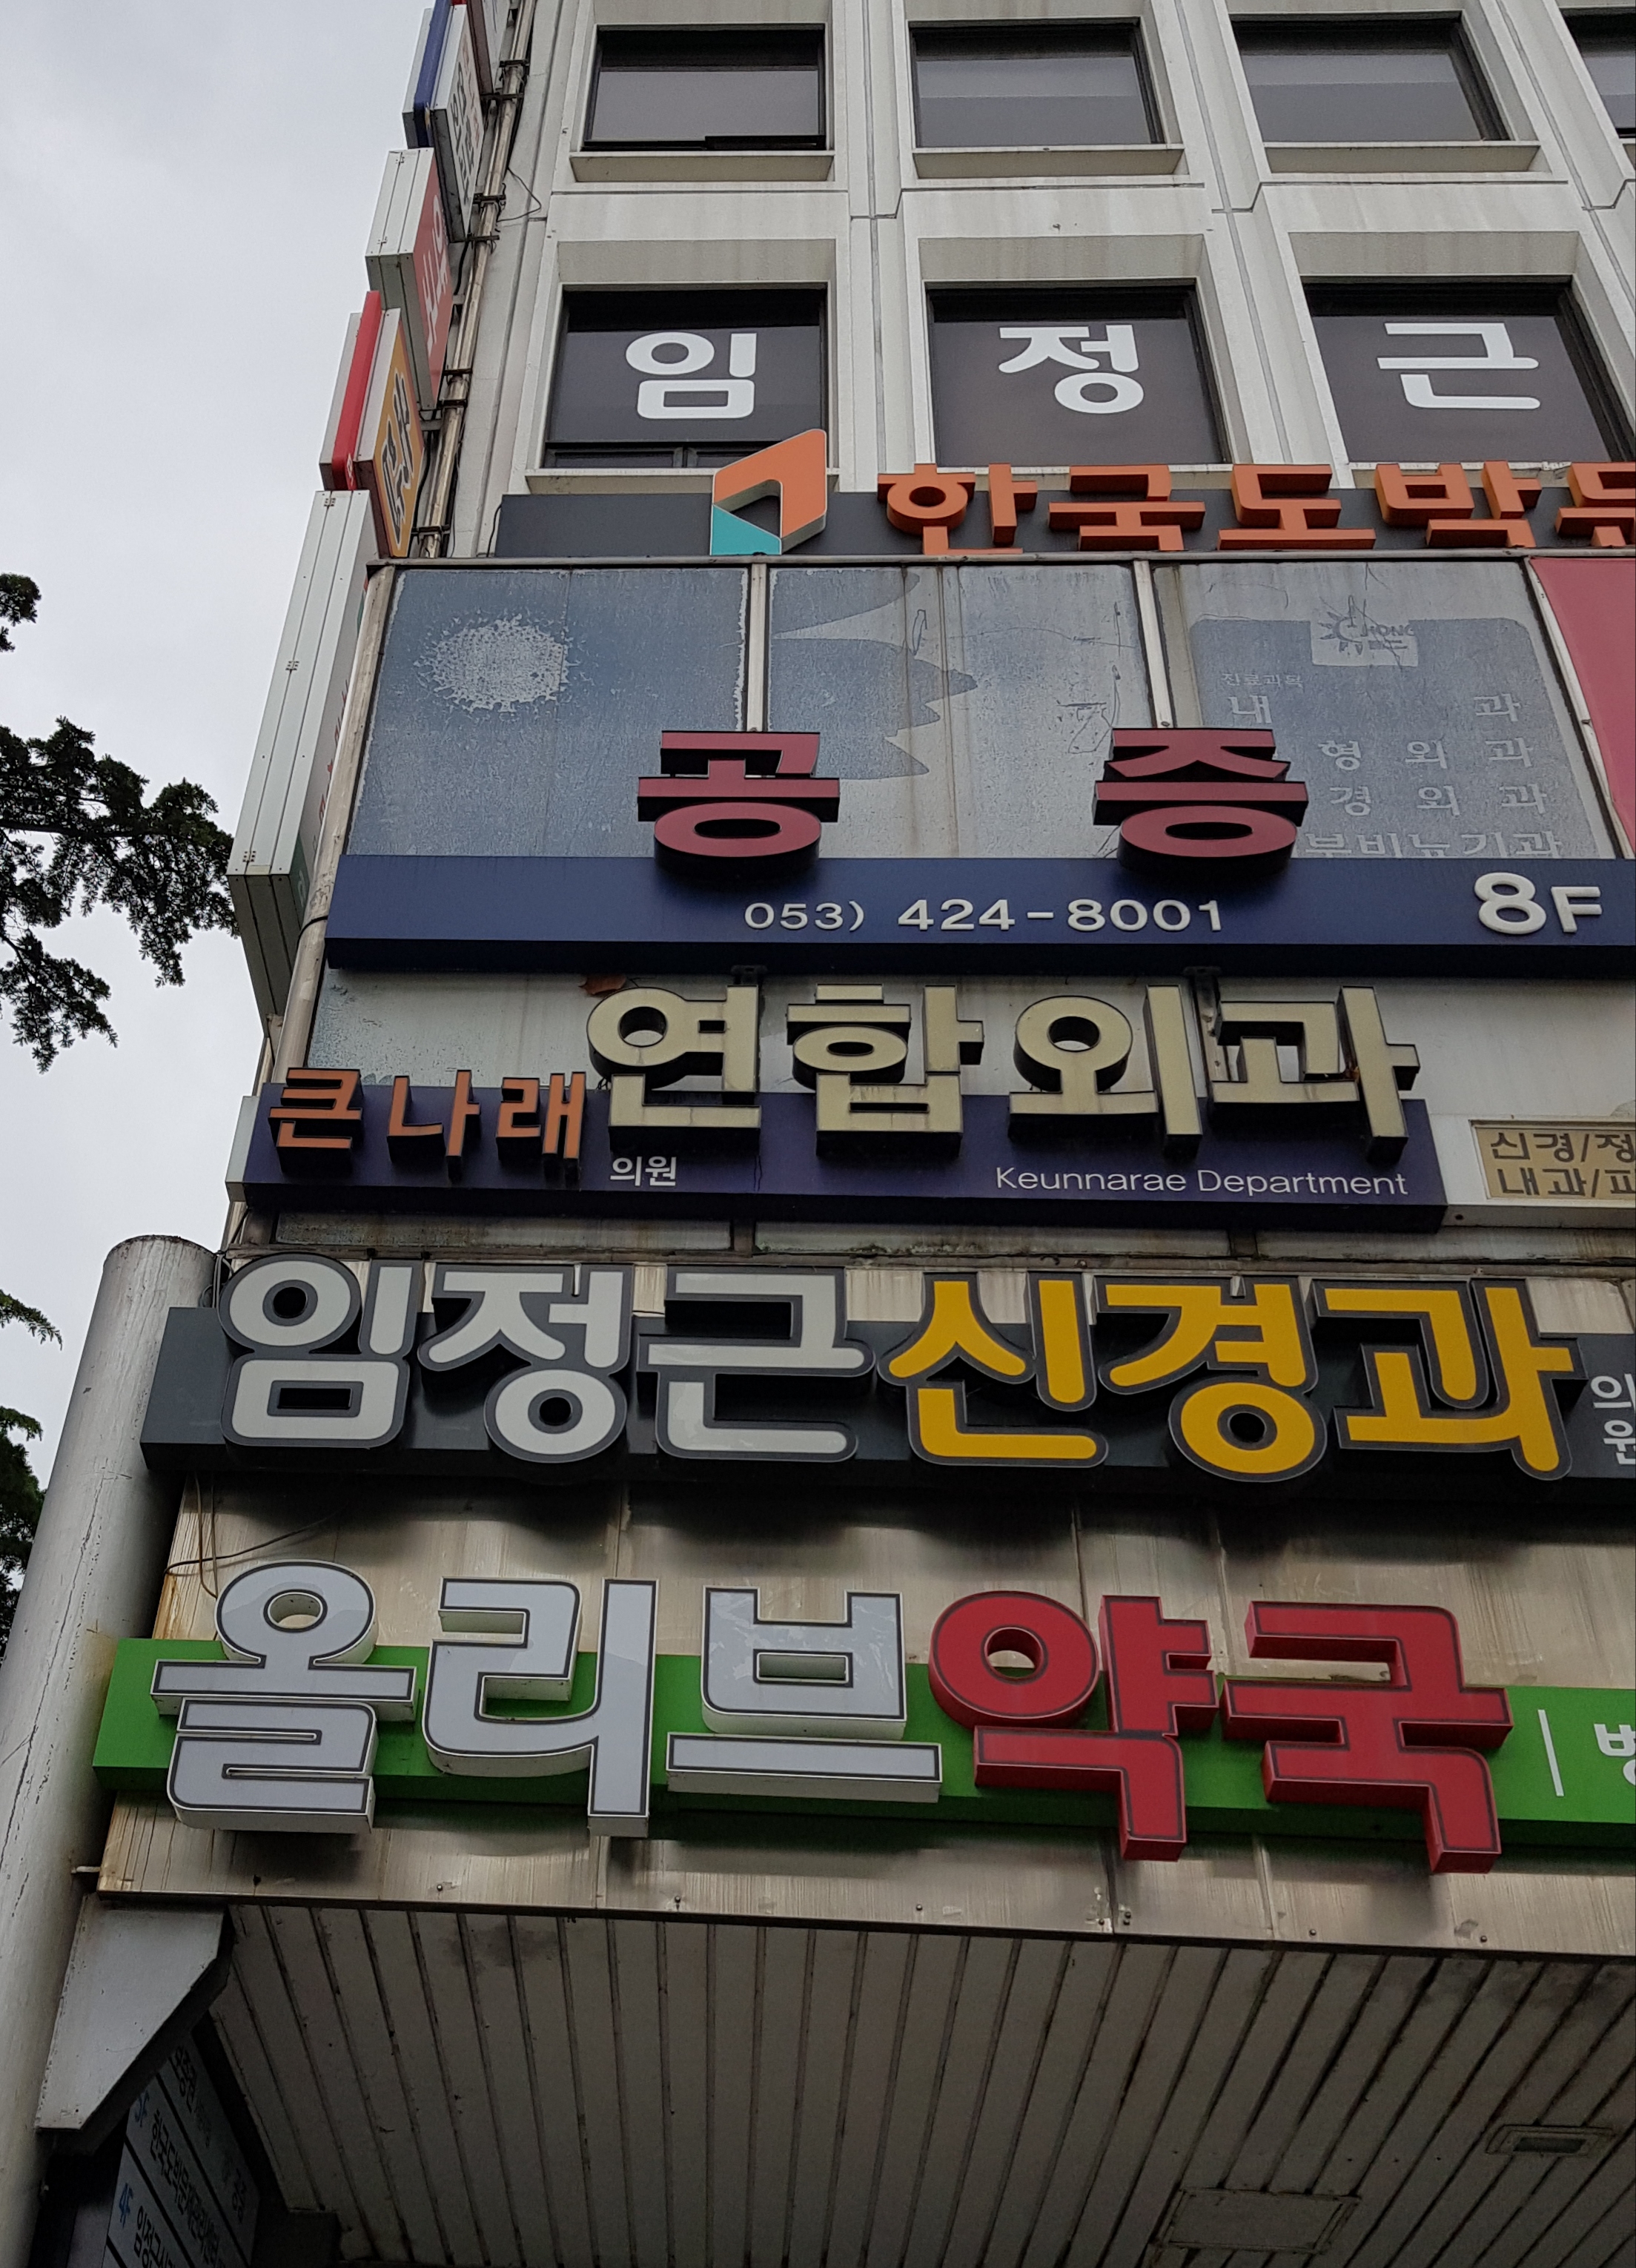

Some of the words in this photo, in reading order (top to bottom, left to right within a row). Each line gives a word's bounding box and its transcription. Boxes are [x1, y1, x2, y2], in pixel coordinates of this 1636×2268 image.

[422, 194, 448, 359] 약국
[744, 901, 866, 932] 053)
[897, 898, 1224, 932] 424-8001
[587, 984, 1420, 1139] 연합외과
[268, 1067, 586, 1161] 큰나래
[610, 1156, 678, 1187] 의원
[995, 1166, 1188, 1192] Keunnarae
[1197, 1168, 1409, 1197] Department
